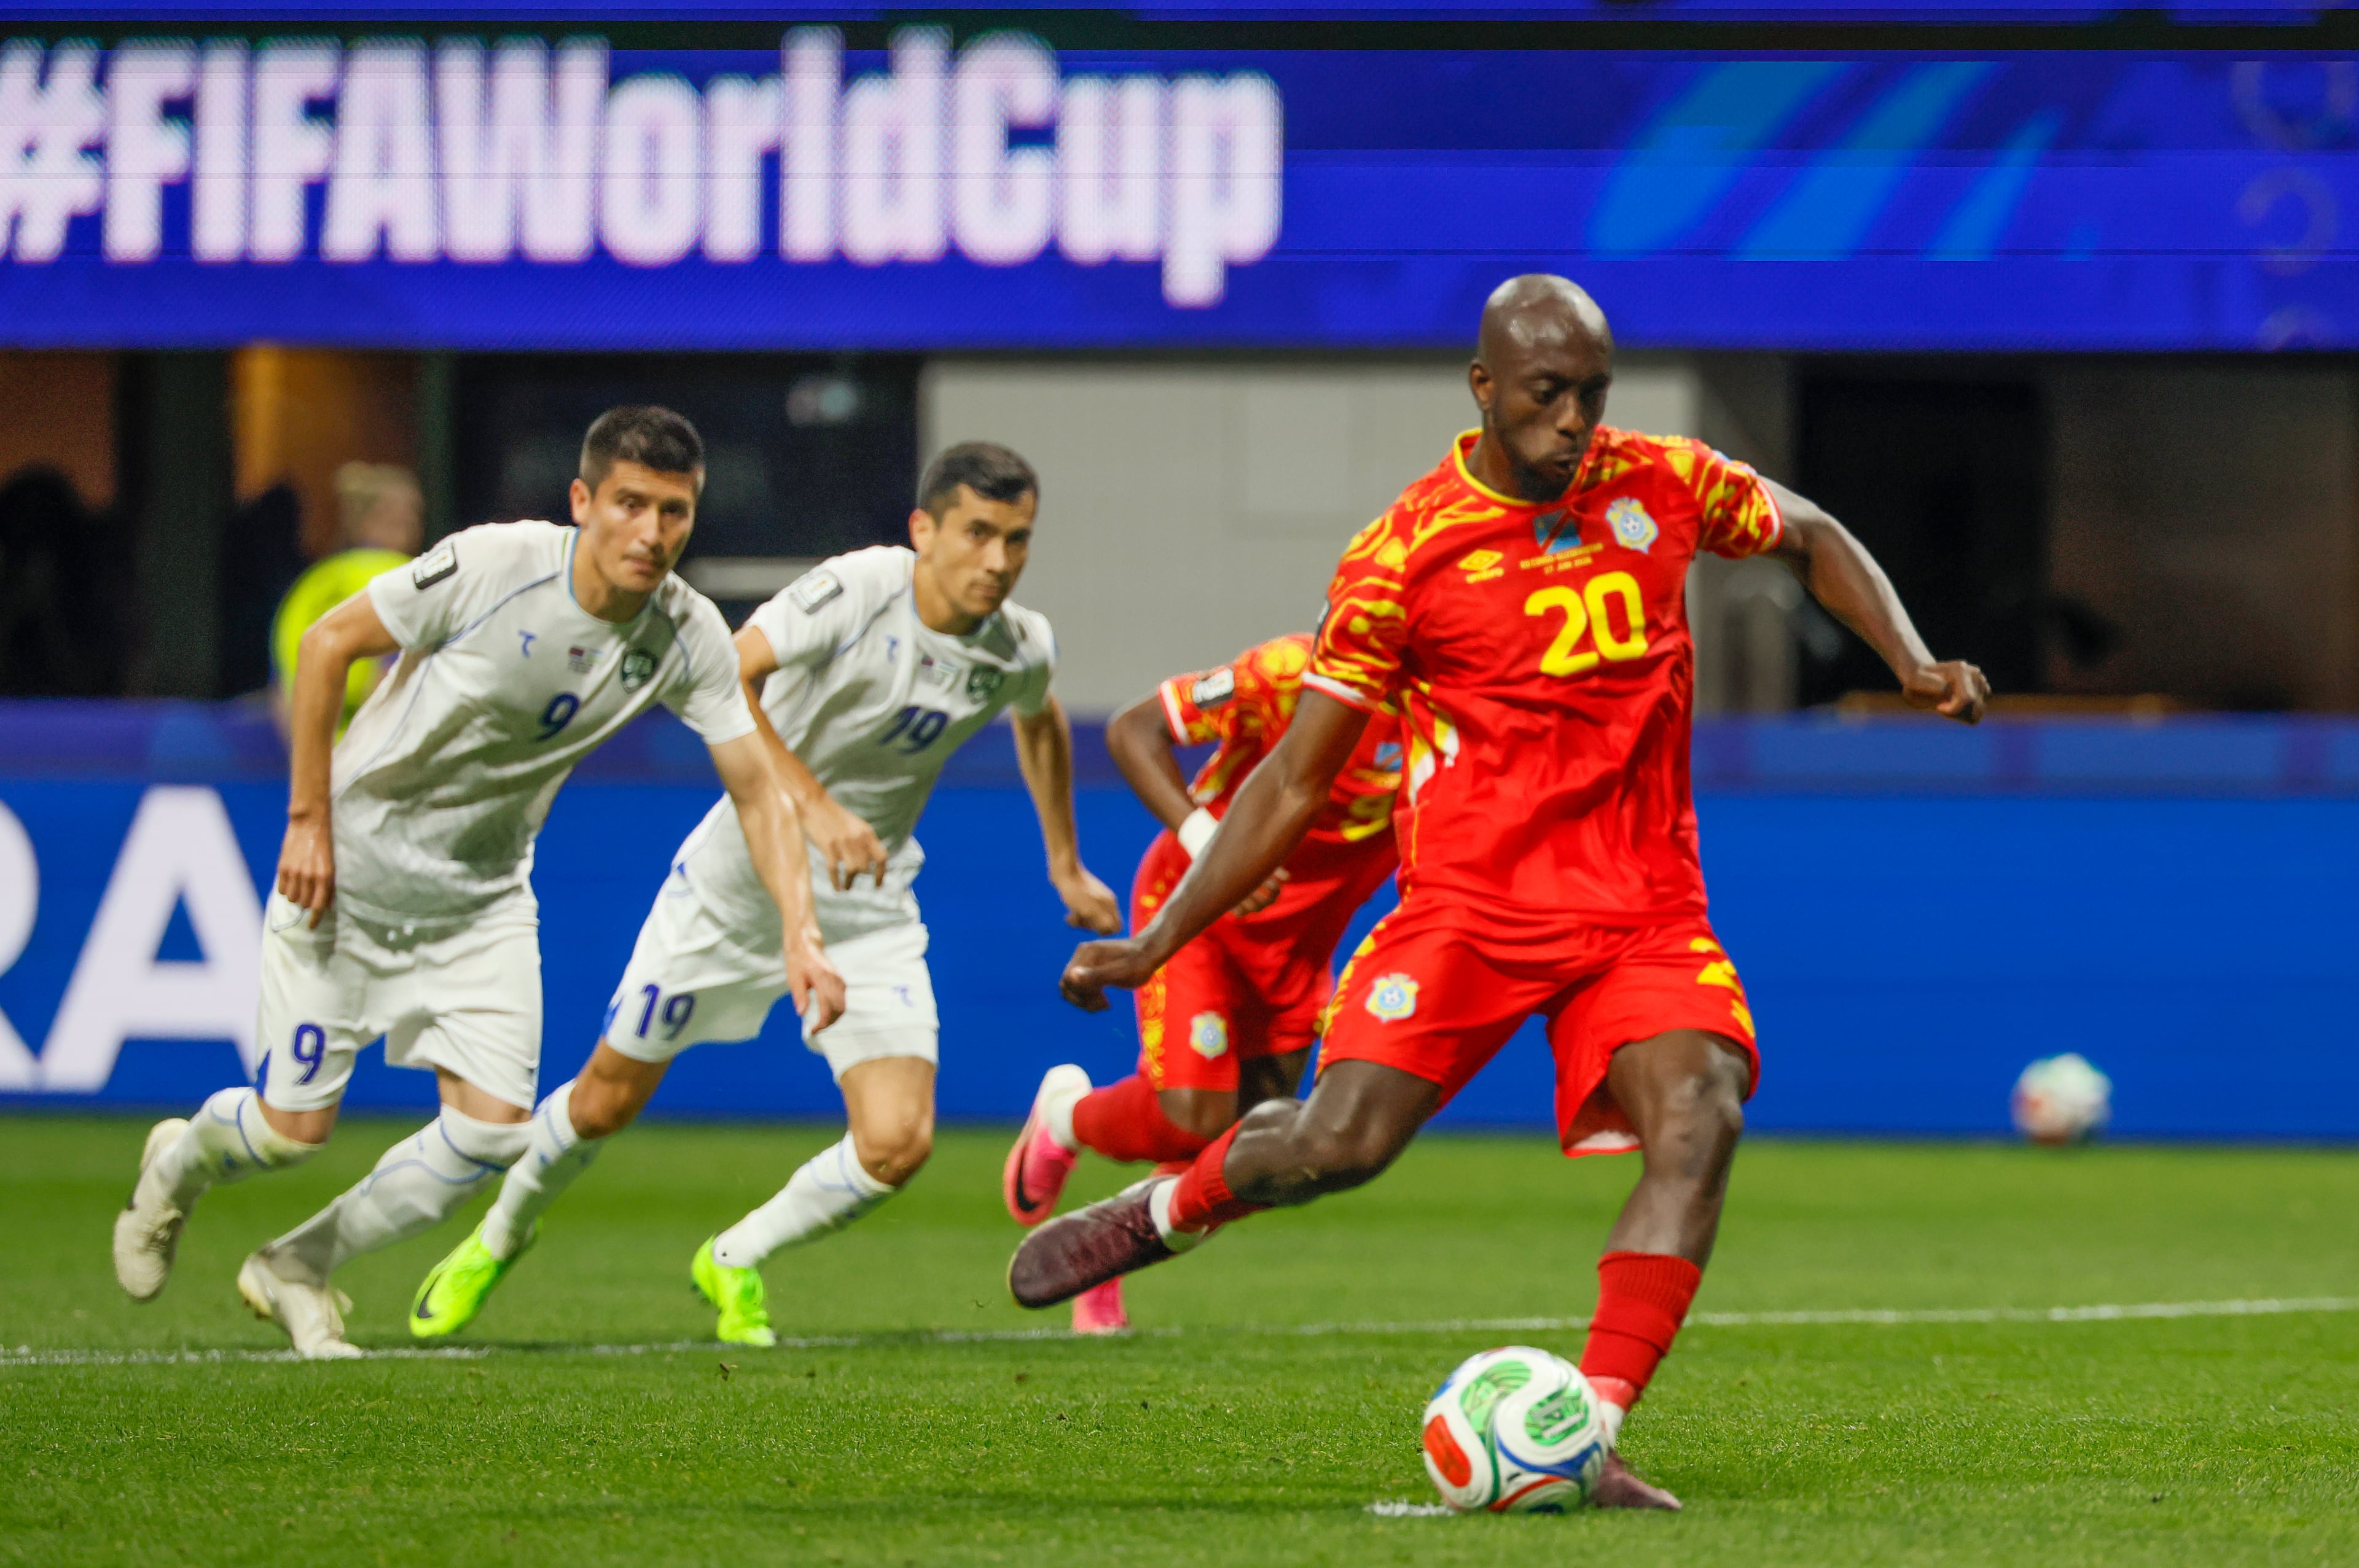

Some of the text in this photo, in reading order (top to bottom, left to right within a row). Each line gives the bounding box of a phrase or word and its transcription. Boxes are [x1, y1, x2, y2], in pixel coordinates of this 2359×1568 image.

[0, 23, 1282, 309] #FIFAWorldCup
[1525, 571, 1648, 677] 20
[537, 692, 579, 742] 9
[878, 706, 948, 755] 19
[635, 983, 695, 1042] 19
[292, 1023, 326, 1086] 9
